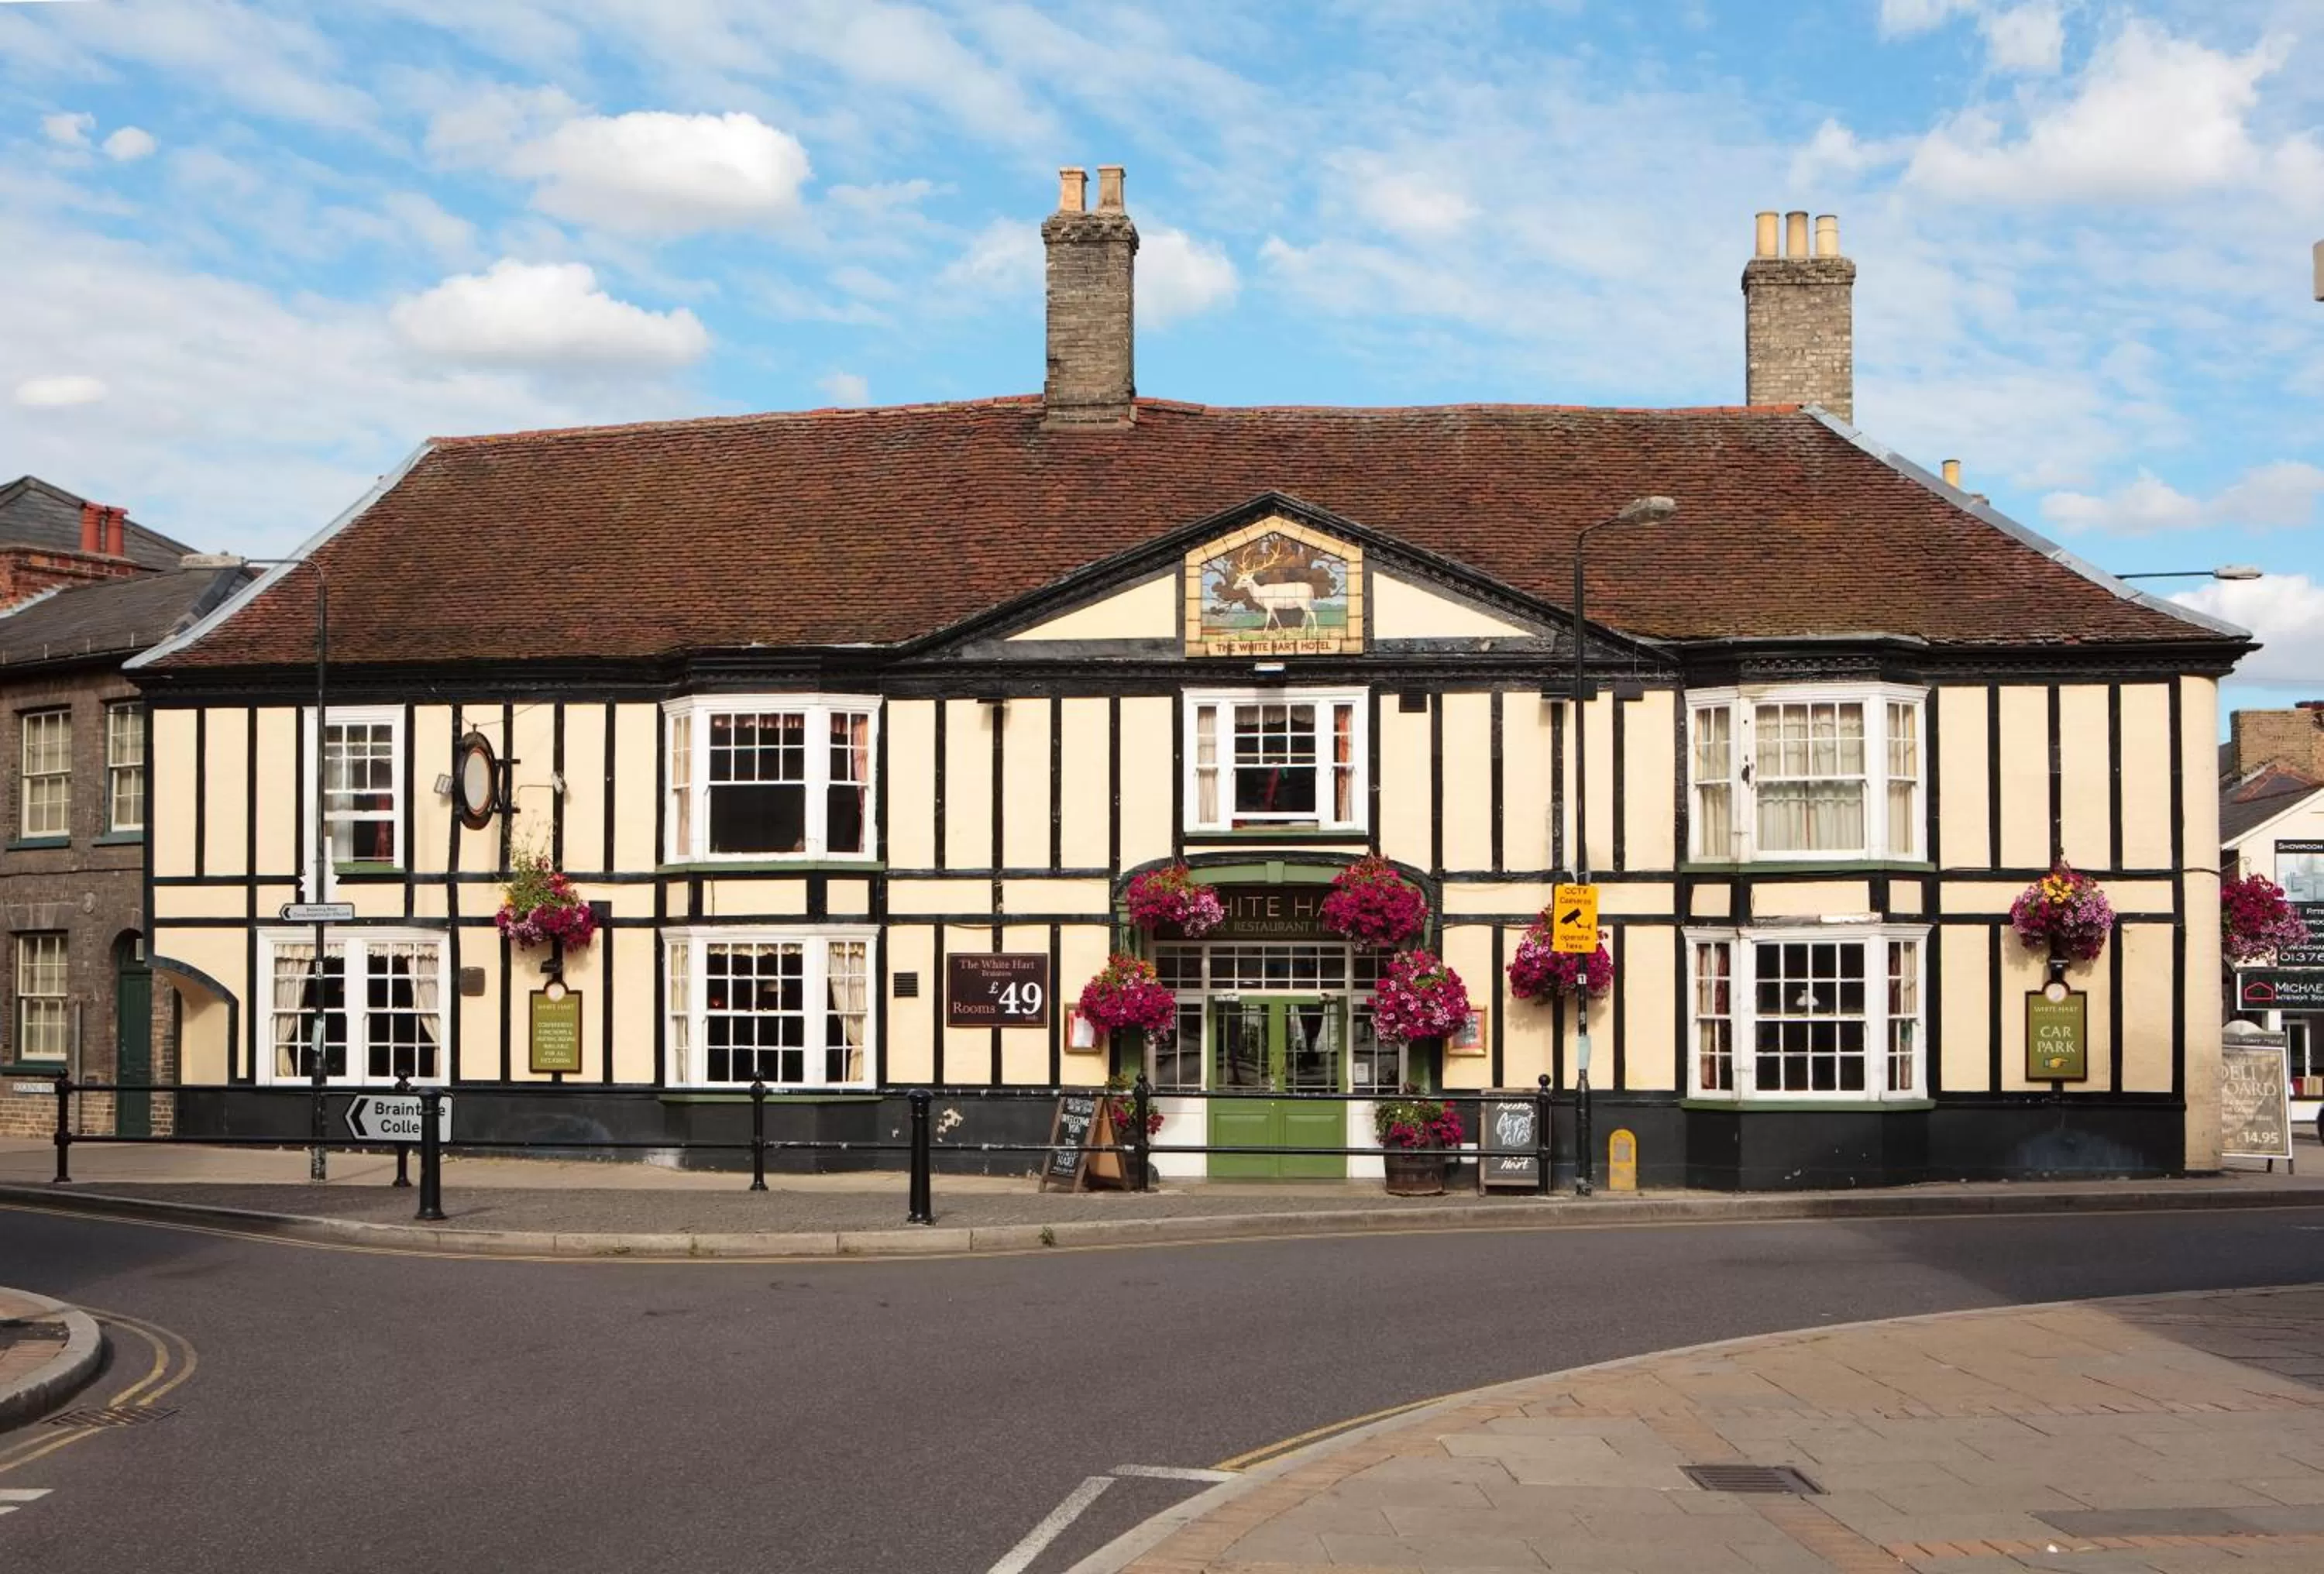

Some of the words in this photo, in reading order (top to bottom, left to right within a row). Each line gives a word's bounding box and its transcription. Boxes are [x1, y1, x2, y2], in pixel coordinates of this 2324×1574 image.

[1216, 644, 1236, 652] THE
[1239, 642, 1268, 651] WHITE
[1272, 642, 1297, 651] HART
[1301, 641, 1331, 651] HOTEL
[1221, 895, 1281, 917] HITE
[1234, 921, 1308, 931] RESTAURANT
[961, 960, 978, 969] The
[982, 960, 1010, 969] White
[1012, 960, 1035, 969] Hart
[953, 1002, 995, 1014] Rooms
[2040, 1026, 2071, 1038] CAR
[2037, 1040, 2076, 1053] PARK
[2224, 1083, 2278, 1097] OARD
[374, 1101, 446, 1116] Brainte
[380, 1119, 421, 1133] Colle
